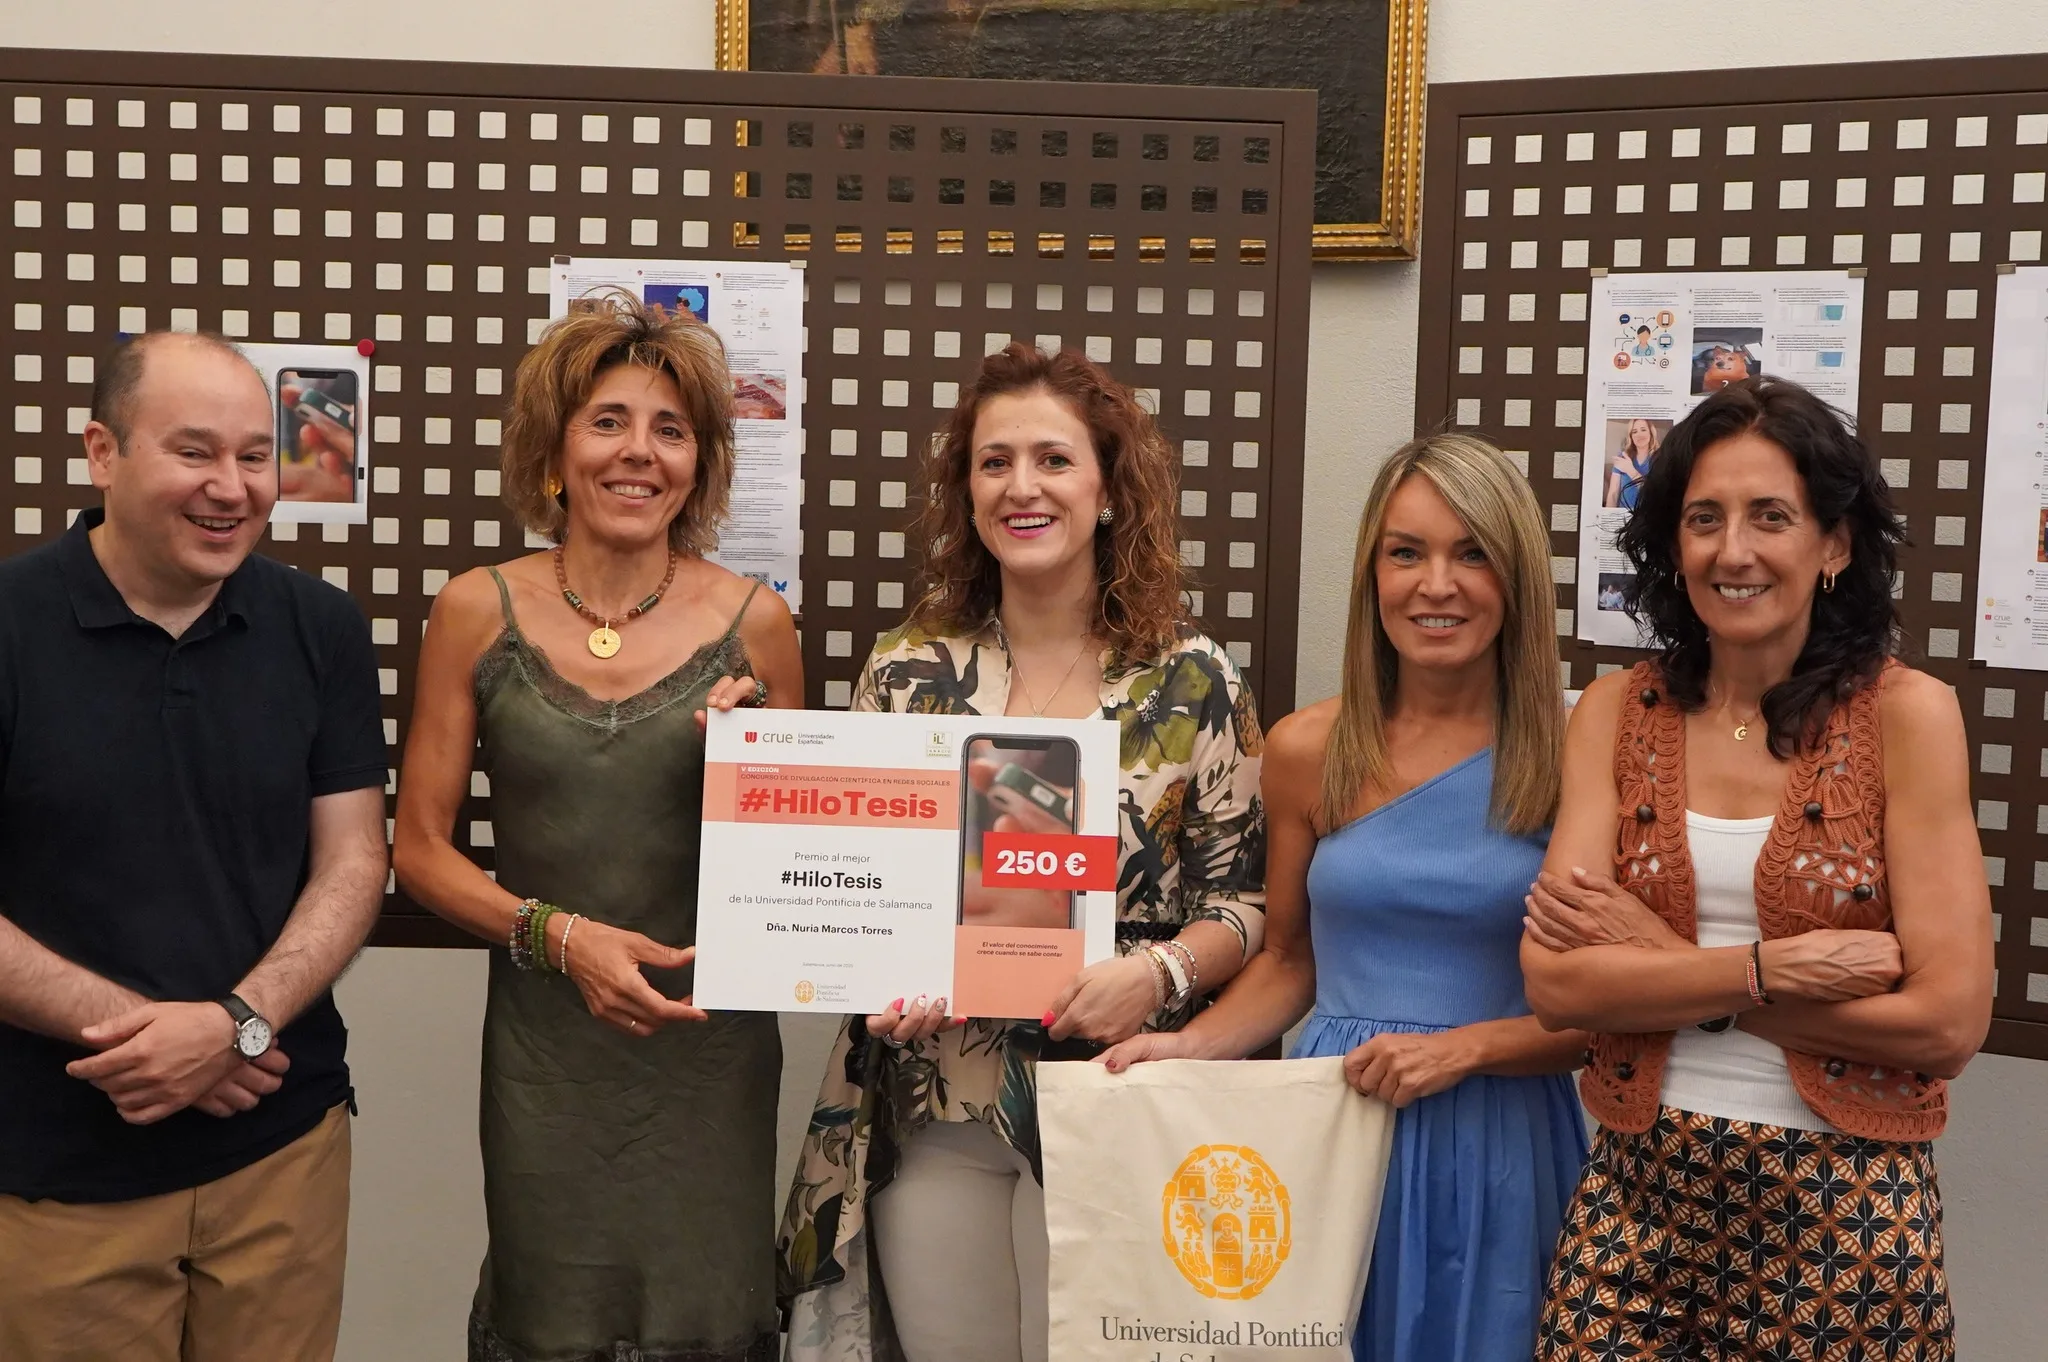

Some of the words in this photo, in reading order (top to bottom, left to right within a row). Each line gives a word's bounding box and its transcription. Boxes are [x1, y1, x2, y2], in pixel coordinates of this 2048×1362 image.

[762, 732, 793, 744] crue
[747, 765, 779, 773] EDICIÓN
[790, 775, 839, 783] DIVULGACIÓN
[840, 776, 881, 784] CIENTÍFICA
[740, 787, 938, 819] #HiloTesis
[794, 852, 829, 862] Premio
[831, 853, 840, 862] al
[842, 854, 871, 864] mejor
[996, 850, 1058, 876] 250
[1064, 852, 1087, 877] €
[781, 870, 883, 889] #HiloTesis
[729, 894, 742, 903] de
[744, 895, 753, 904] la
[755, 895, 813, 906] Universidad
[816, 897, 861, 908] Pontificia
[863, 898, 877, 908] de
[879, 899, 933, 910] Salamanca
[766, 922, 790, 932] Dña.
[792, 923, 819, 934] Nuria
[821, 925, 859, 934] Marcos
[861, 926, 893, 935] Torres
[1100, 1316, 1242, 1346] Universidad
